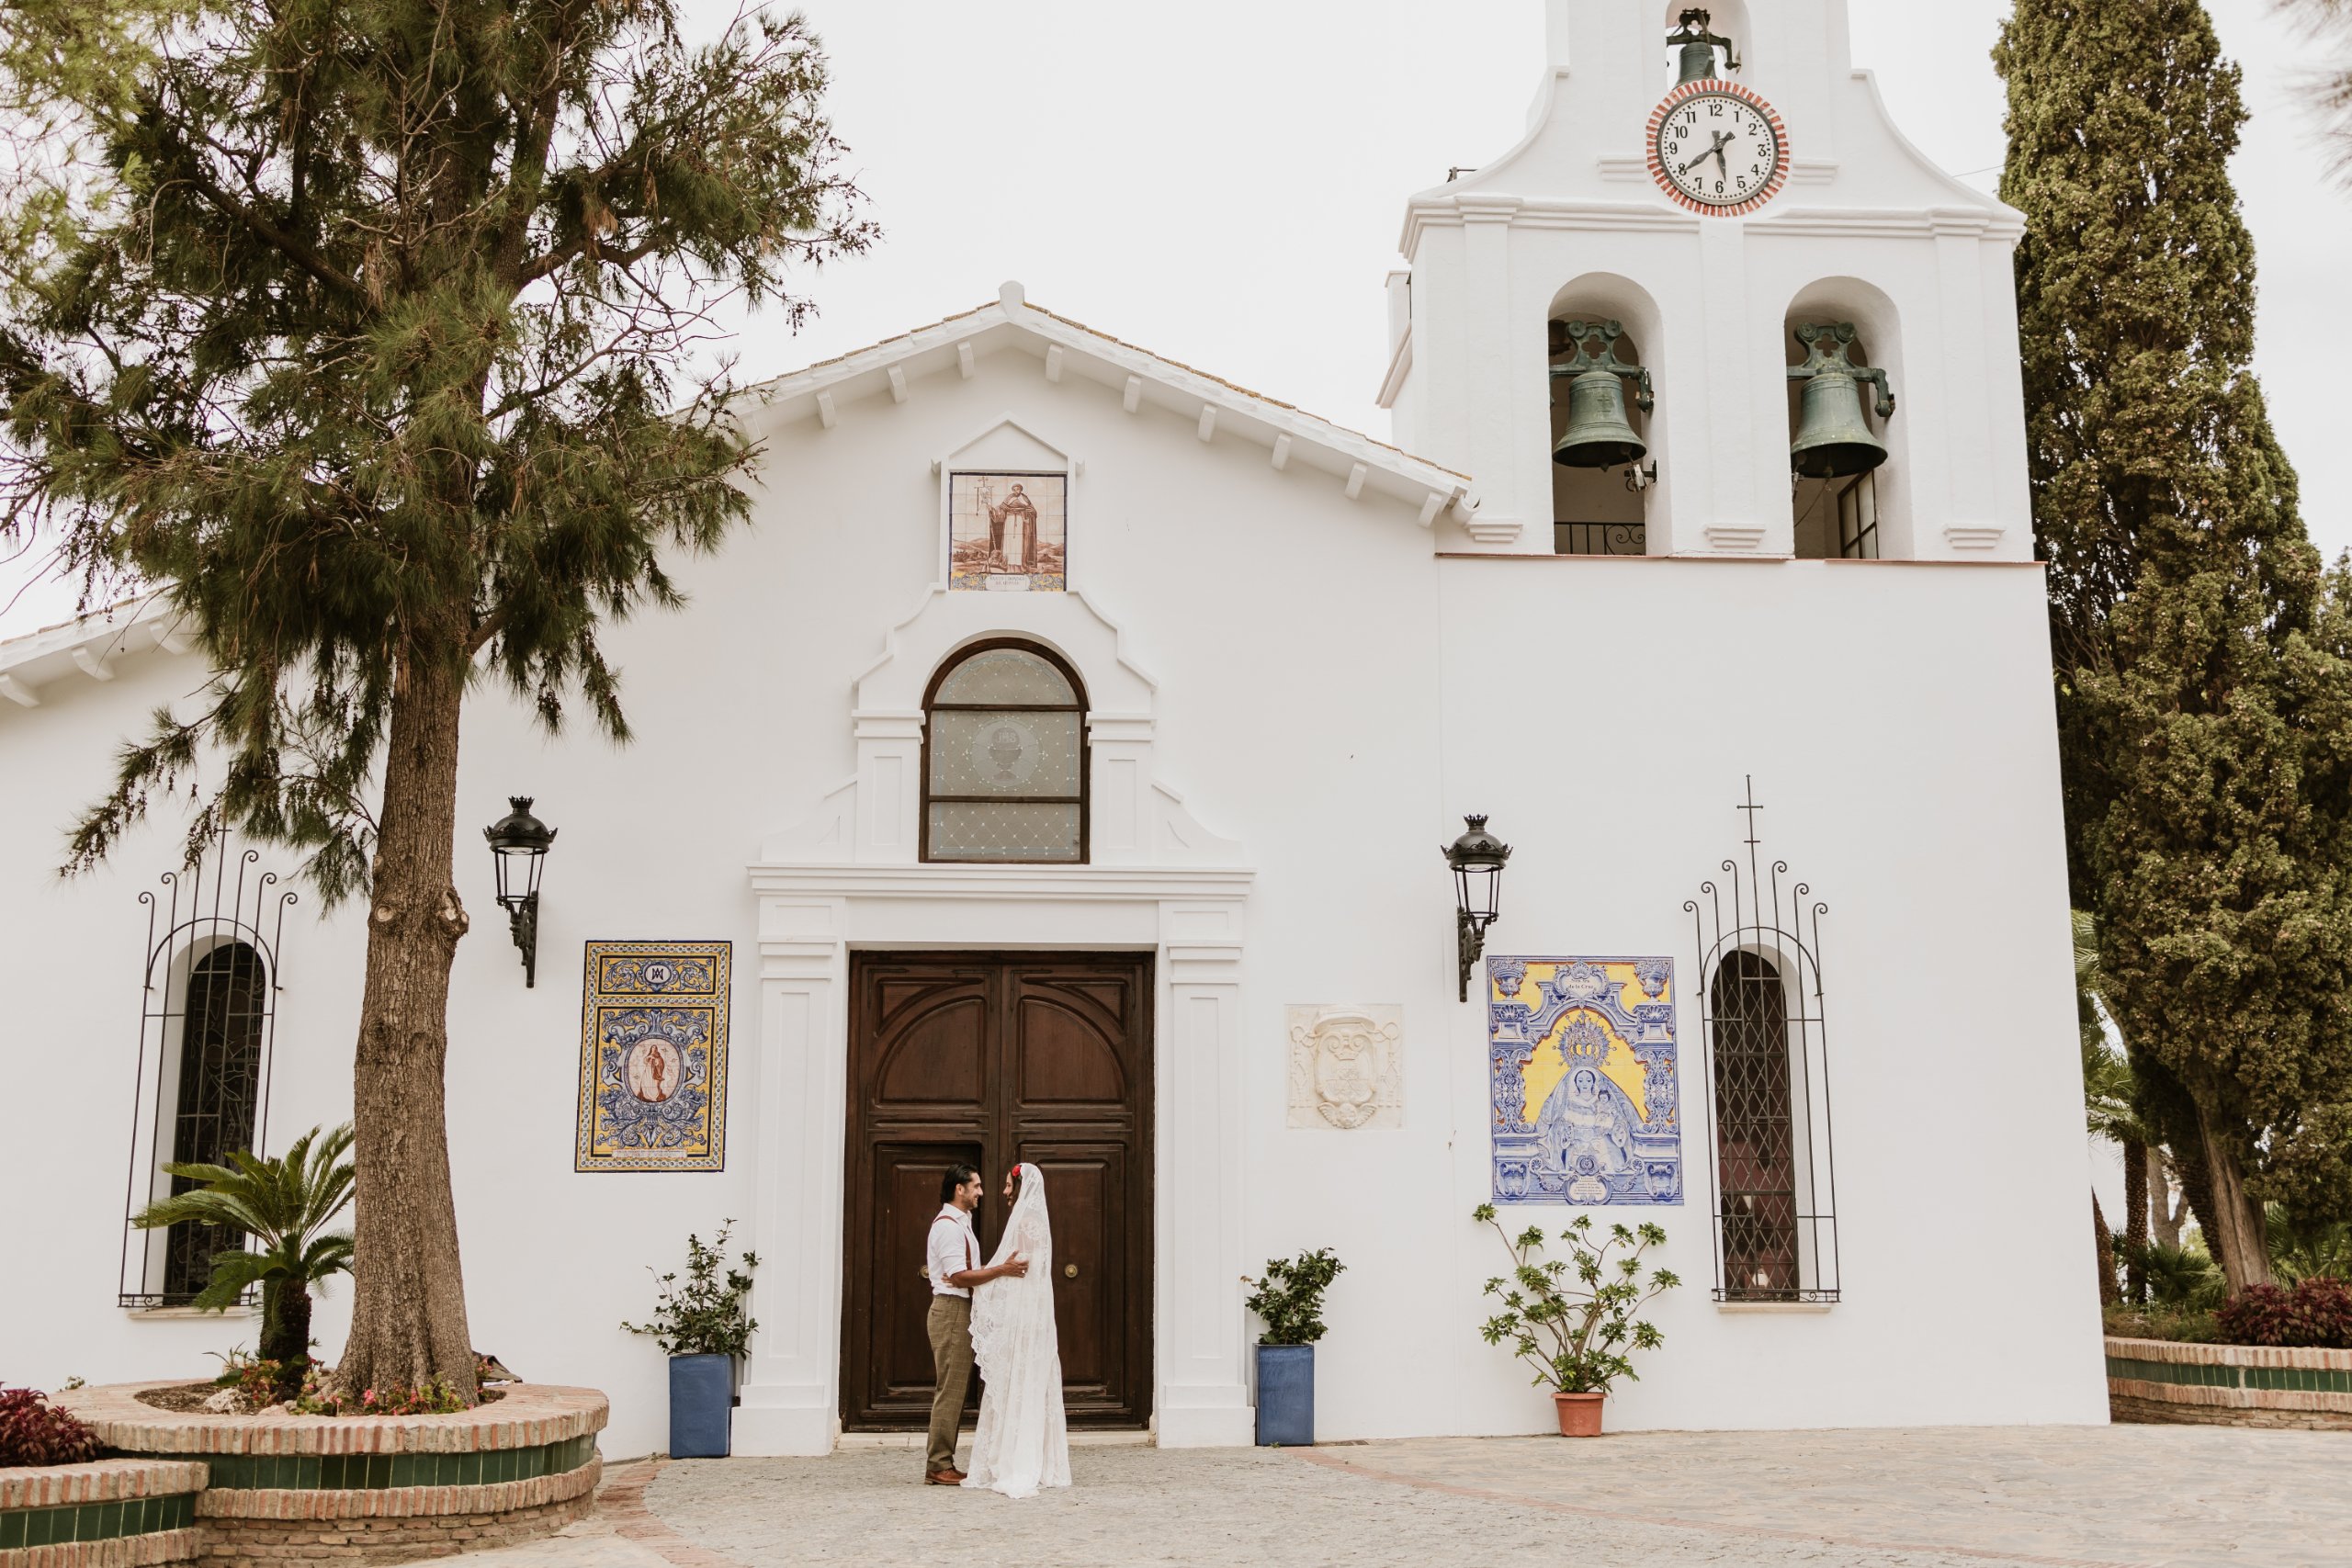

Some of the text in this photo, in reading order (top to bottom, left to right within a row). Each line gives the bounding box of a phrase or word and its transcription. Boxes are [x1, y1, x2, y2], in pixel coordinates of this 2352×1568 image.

[1685, 111, 1696, 123] 11
[1708, 104, 1723, 117] 12
[1735, 111, 1739, 123] 1
[1674, 125, 1688, 139] 10
[1748, 123, 1758, 136] 2
[1668, 141, 1678, 154] 9
[1758, 143, 1767, 157] 3
[1678, 163, 1687, 175] 8
[1750, 164, 1759, 176] 4
[1694, 176, 1702, 189] 7
[1715, 180, 1724, 194] 6
[1736, 175, 1746, 188] 5
